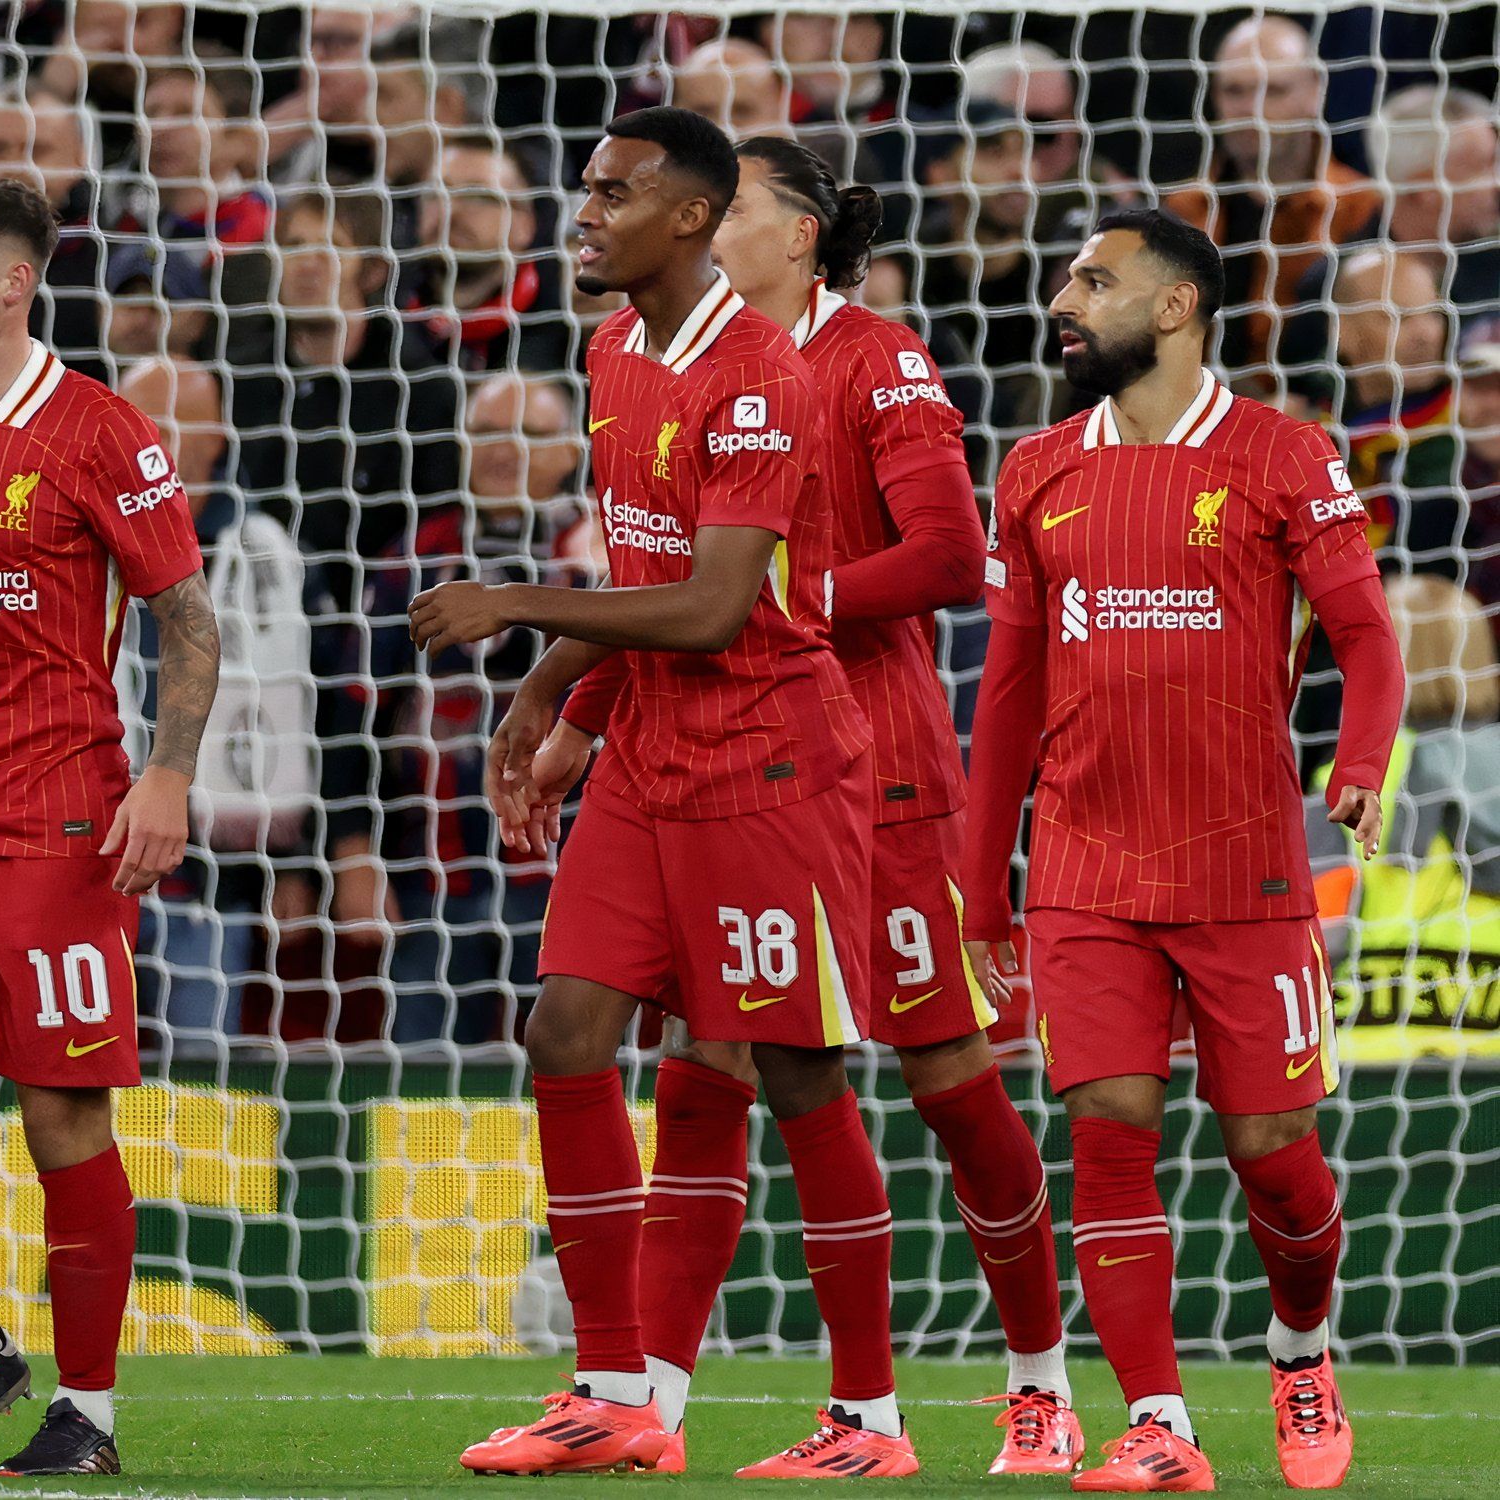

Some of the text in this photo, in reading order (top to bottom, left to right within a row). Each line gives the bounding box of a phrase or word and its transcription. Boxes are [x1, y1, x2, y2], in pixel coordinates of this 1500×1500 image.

[708, 429, 792, 455] Expedia
[1096, 585, 1214, 608] standard
[1096, 608, 1222, 630] chartered
[27, 943, 112, 1028] 10
[718, 906, 799, 988] 38
[887, 906, 936, 986] 9
[1274, 966, 1320, 1055] 11
